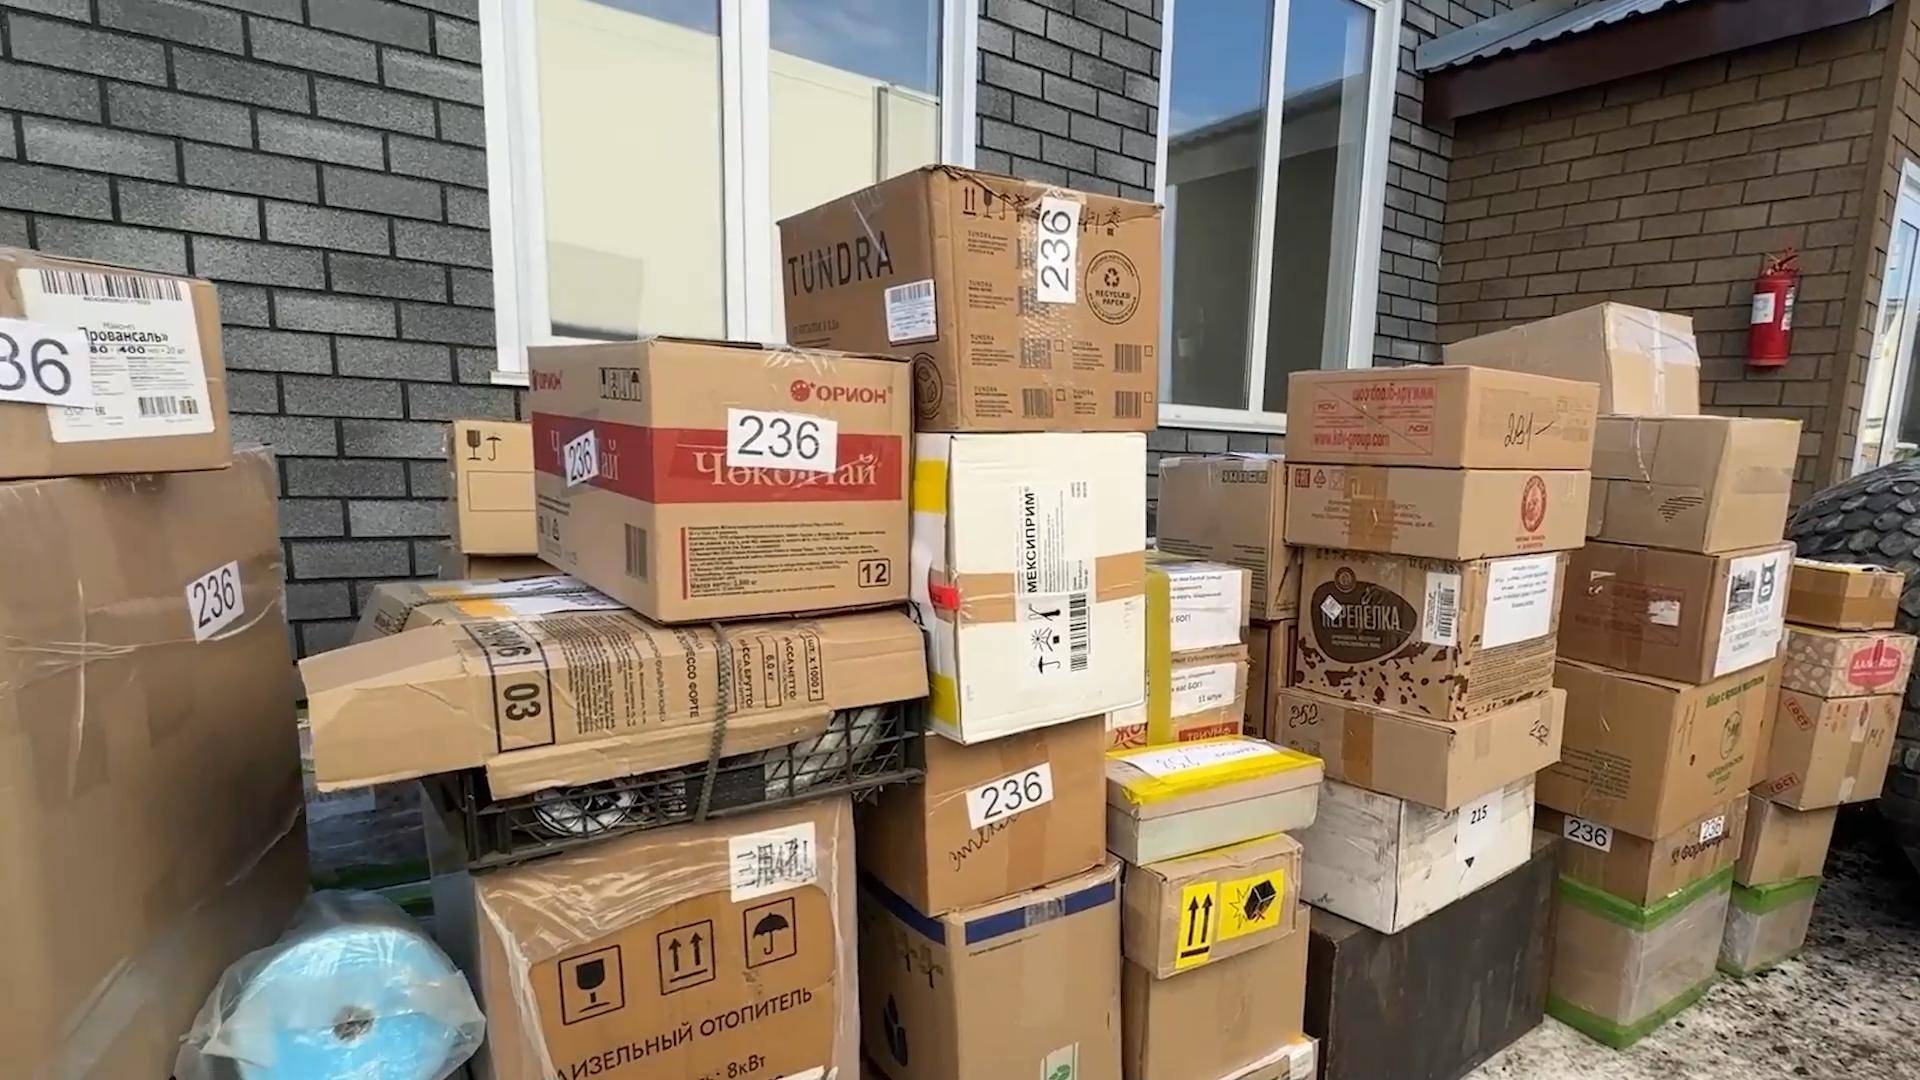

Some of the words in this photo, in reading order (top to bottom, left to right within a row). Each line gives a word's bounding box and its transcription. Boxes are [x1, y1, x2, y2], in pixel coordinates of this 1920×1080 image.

[788, 231, 894, 297] TUNDRA
[1041, 209, 1071, 292] 236
[816, 385, 886, 404] ОРИОН
[738, 414, 820, 460] 236
[569, 438, 593, 481] 236
[1025, 492, 1038, 593] МЕКСИПРИМ
[862, 563, 887, 583] 12
[193, 569, 235, 628] 236
[503, 682, 541, 722] 03
[688, 681, 699, 719] ФОРТЕ
[981, 771, 1043, 820] 236
[1470, 804, 1488, 825] 215
[1569, 819, 1607, 847] 236
[1702, 817, 1722, 840] 236
[700, 987, 813, 1037] ОТОПИТЕЛЬ
[727, 1053, 767, 1079] 8кВт
